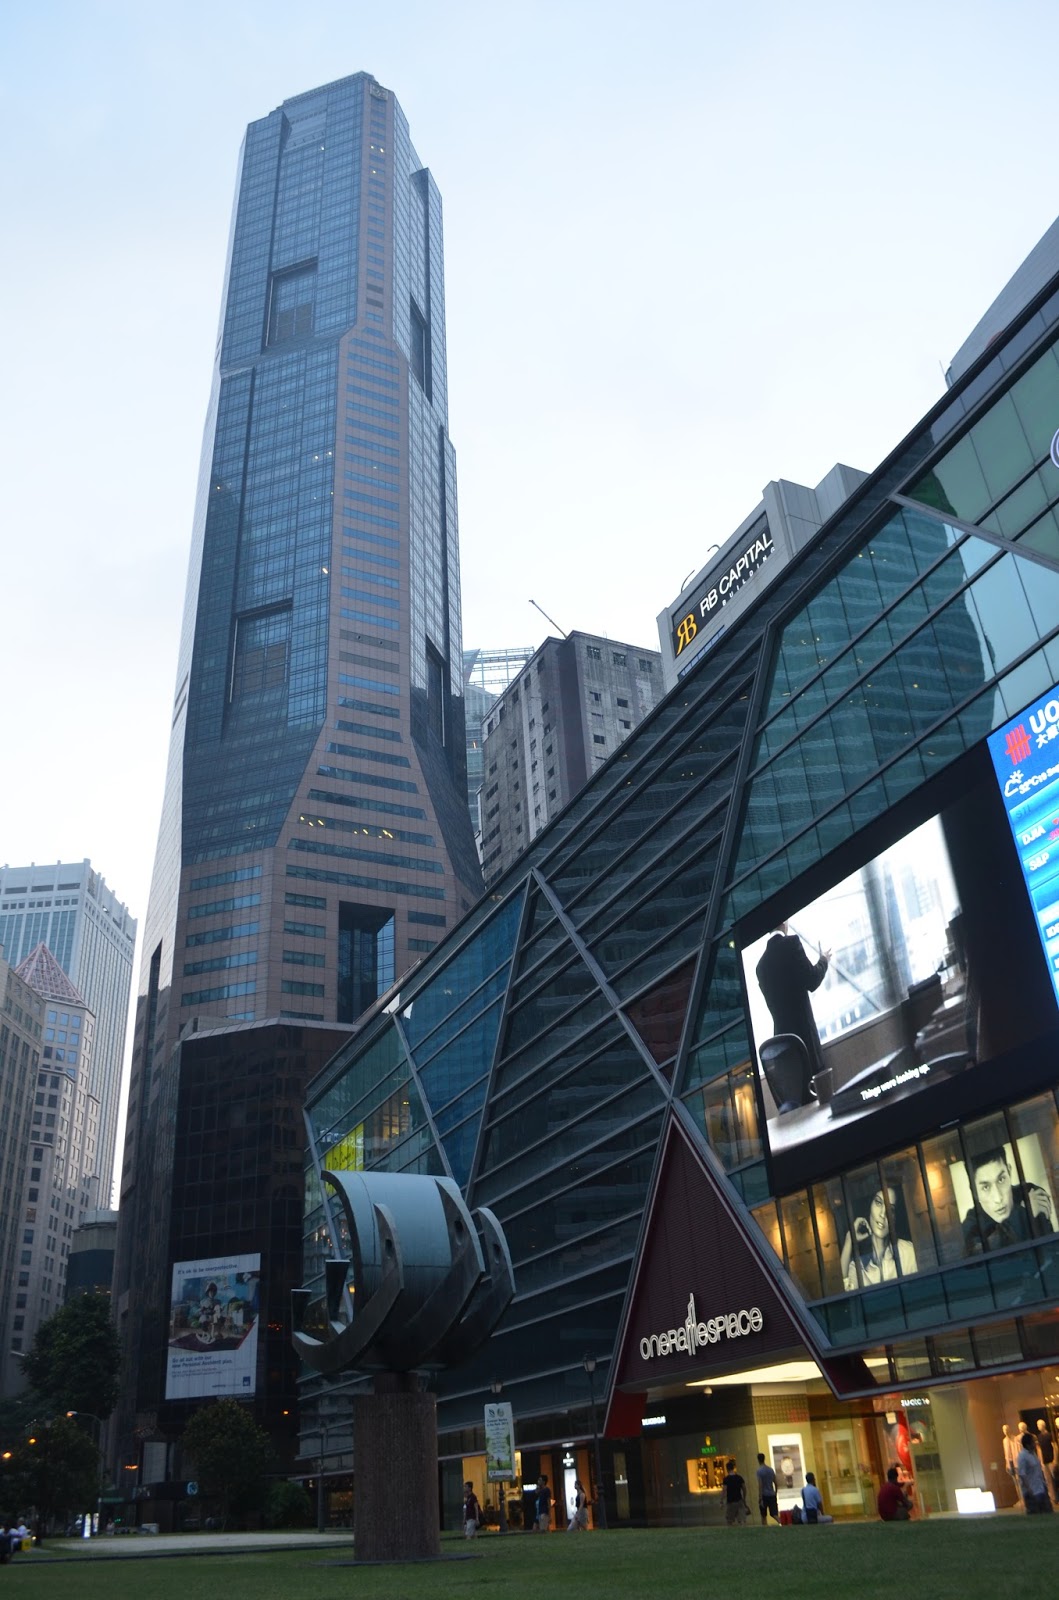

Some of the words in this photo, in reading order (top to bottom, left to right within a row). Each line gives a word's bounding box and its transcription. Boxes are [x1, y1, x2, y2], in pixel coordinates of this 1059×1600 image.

[700, 588, 718, 617] RB
[719, 533, 773, 595] CAPITAL
[721, 546, 775, 606] BUILDING
[1029, 699, 1059, 733] UO
[1021, 825, 1046, 846] DJIA
[1029, 852, 1050, 871] S&P
[860, 1085, 881, 1100] Things
[880, 1078, 897, 1091] were
[895, 1067, 920, 1084] looking
